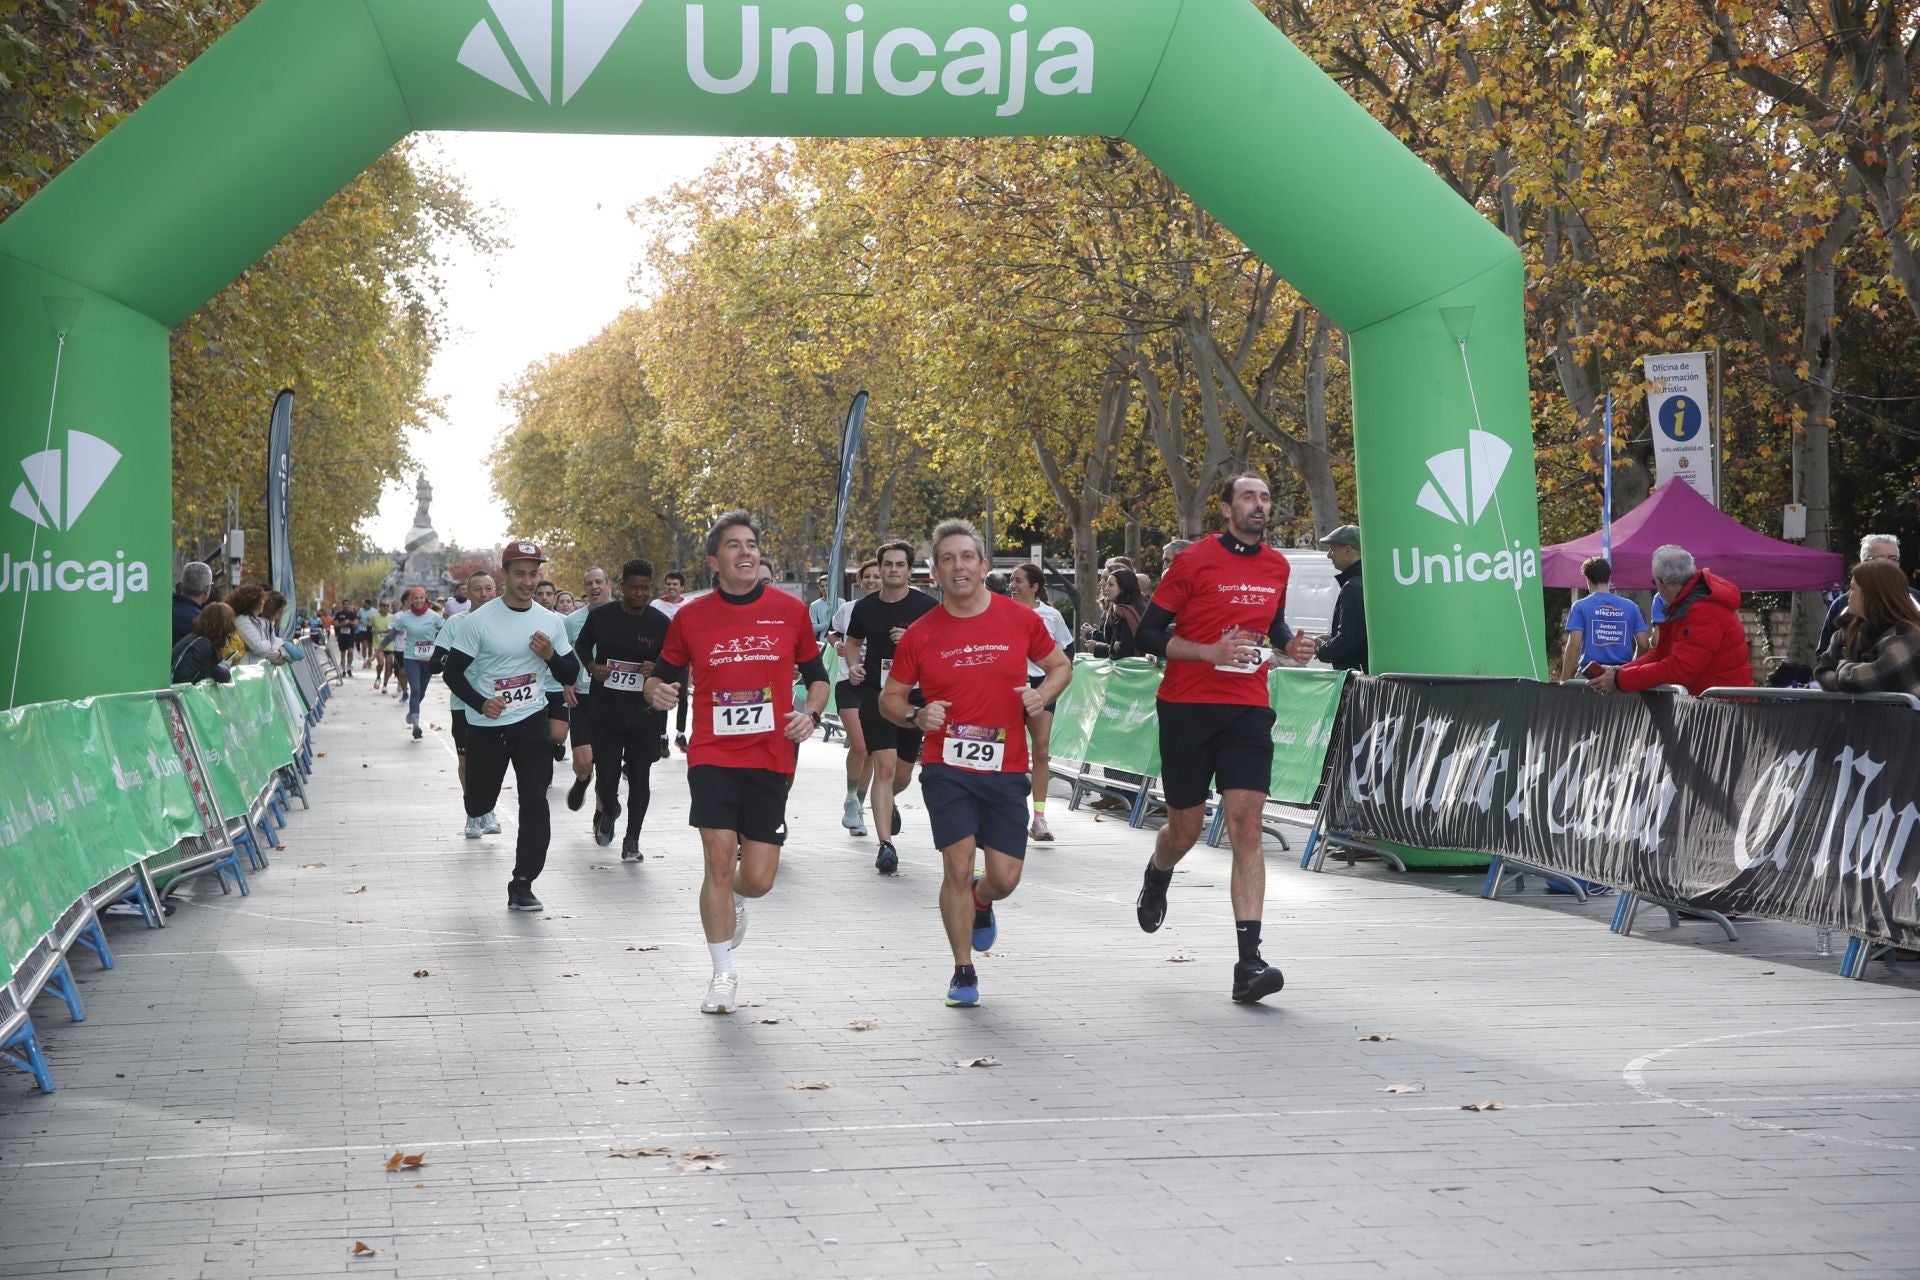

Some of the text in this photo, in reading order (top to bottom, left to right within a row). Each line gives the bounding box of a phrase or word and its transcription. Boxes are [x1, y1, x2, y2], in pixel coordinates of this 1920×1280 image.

[686, 3, 1096, 117] Unicaja
[1652, 364, 1679, 372] Oficina
[1653, 372, 1699, 381] Información
[1393, 540, 1536, 591] Unicaja
[1218, 584, 1276, 594] Sports Santander
[941, 643, 1010, 659] Sports Santander
[709, 654, 779, 667] Sports Santander
[611, 672, 637, 686] 975
[502, 686, 533, 704] 842
[722, 706, 763, 726] 127
[953, 741, 994, 762] 129
[1734, 747, 1818, 872] El
